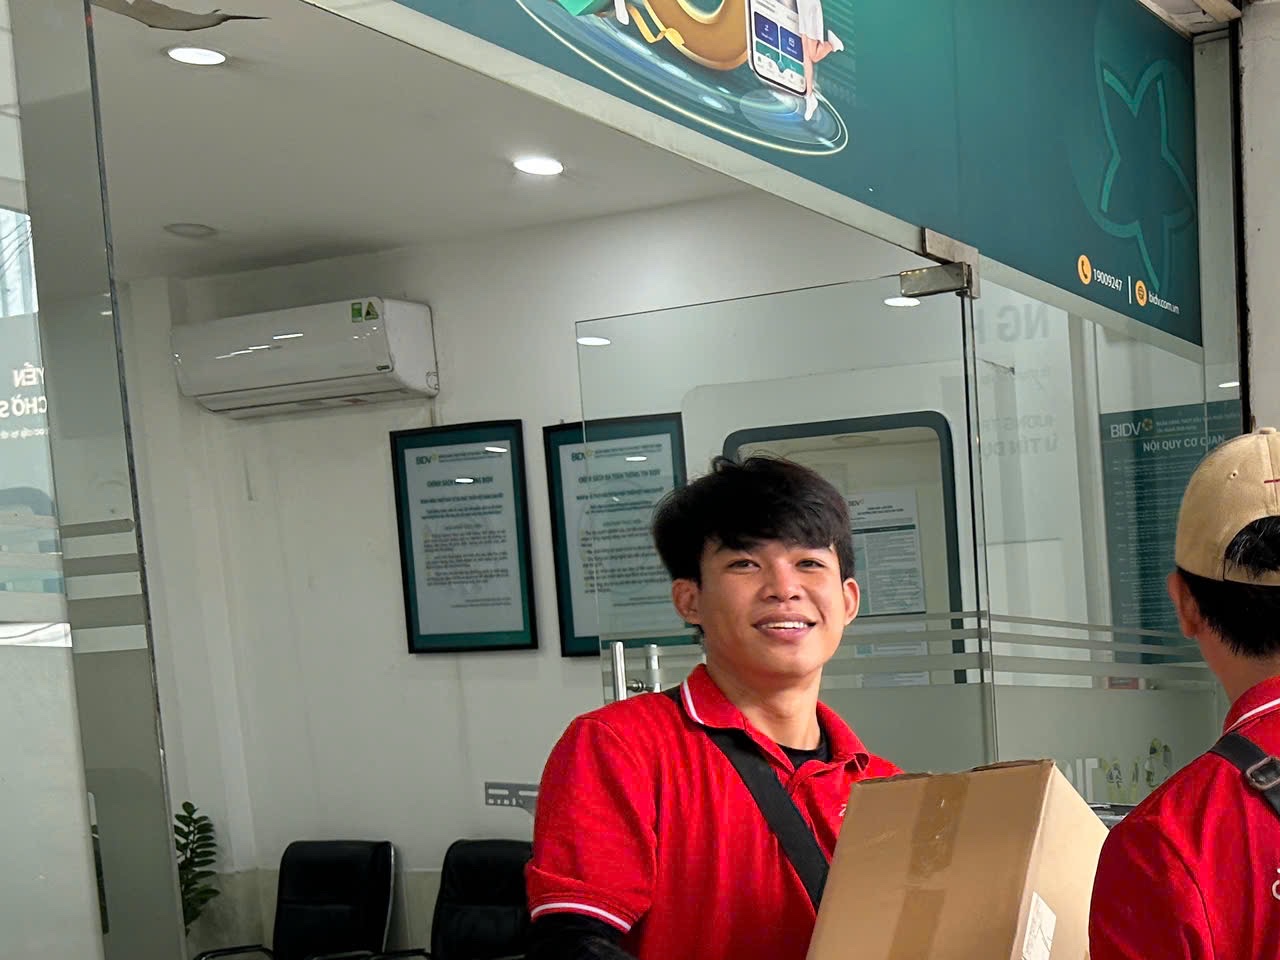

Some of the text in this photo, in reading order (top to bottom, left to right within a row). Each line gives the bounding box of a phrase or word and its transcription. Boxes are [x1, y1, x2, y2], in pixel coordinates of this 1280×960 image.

[1093, 268, 1123, 292] 19009247
[1148, 290, 1180, 315] bidv.com.vn
[1110, 422, 1141, 438] BIDV
[1143, 441, 1160, 453] NỘI
[1162, 439, 1182, 450] QUY
[1184, 438, 1198, 448] CƠ
